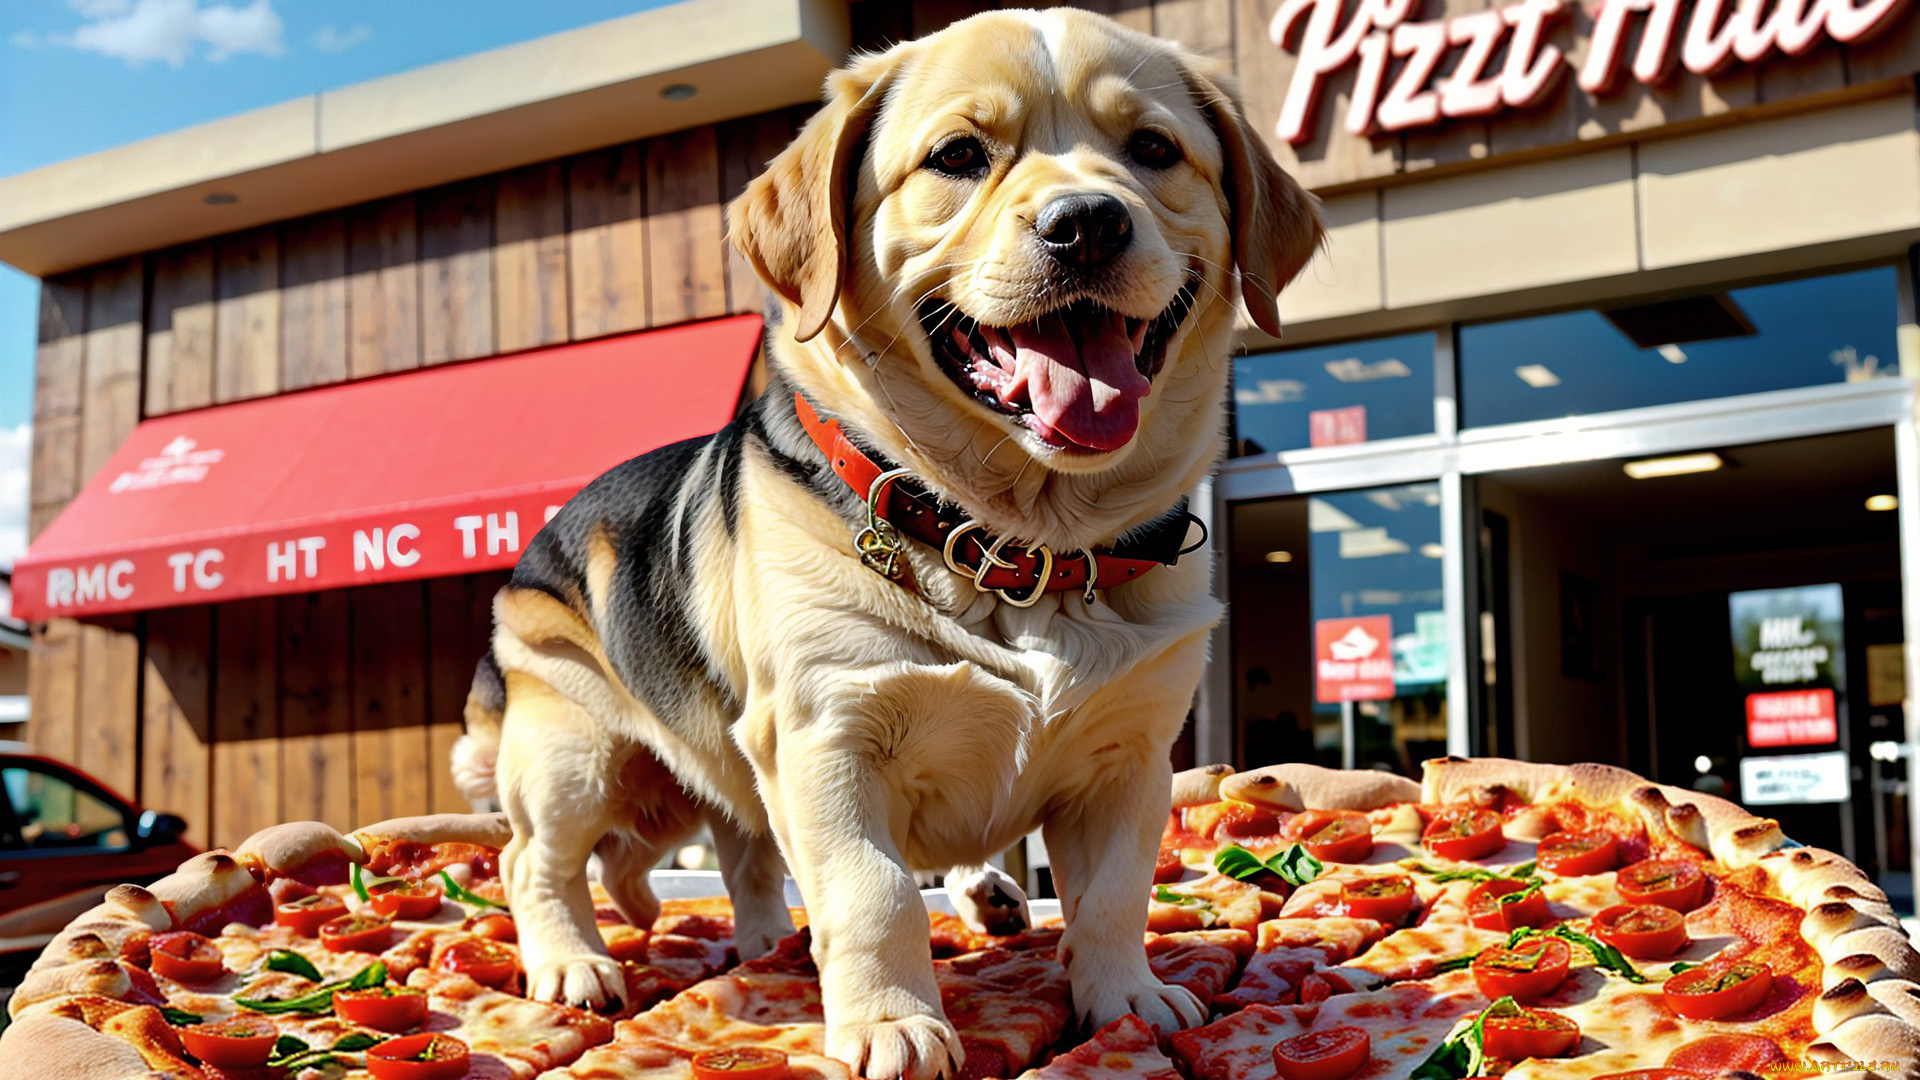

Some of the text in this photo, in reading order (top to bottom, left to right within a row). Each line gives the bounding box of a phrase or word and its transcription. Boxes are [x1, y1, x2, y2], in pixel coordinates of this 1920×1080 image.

[167, 548, 225, 593] TC
[266, 536, 327, 583] HT
[353, 523, 421, 572] NC
[453, 511, 520, 559] TH
